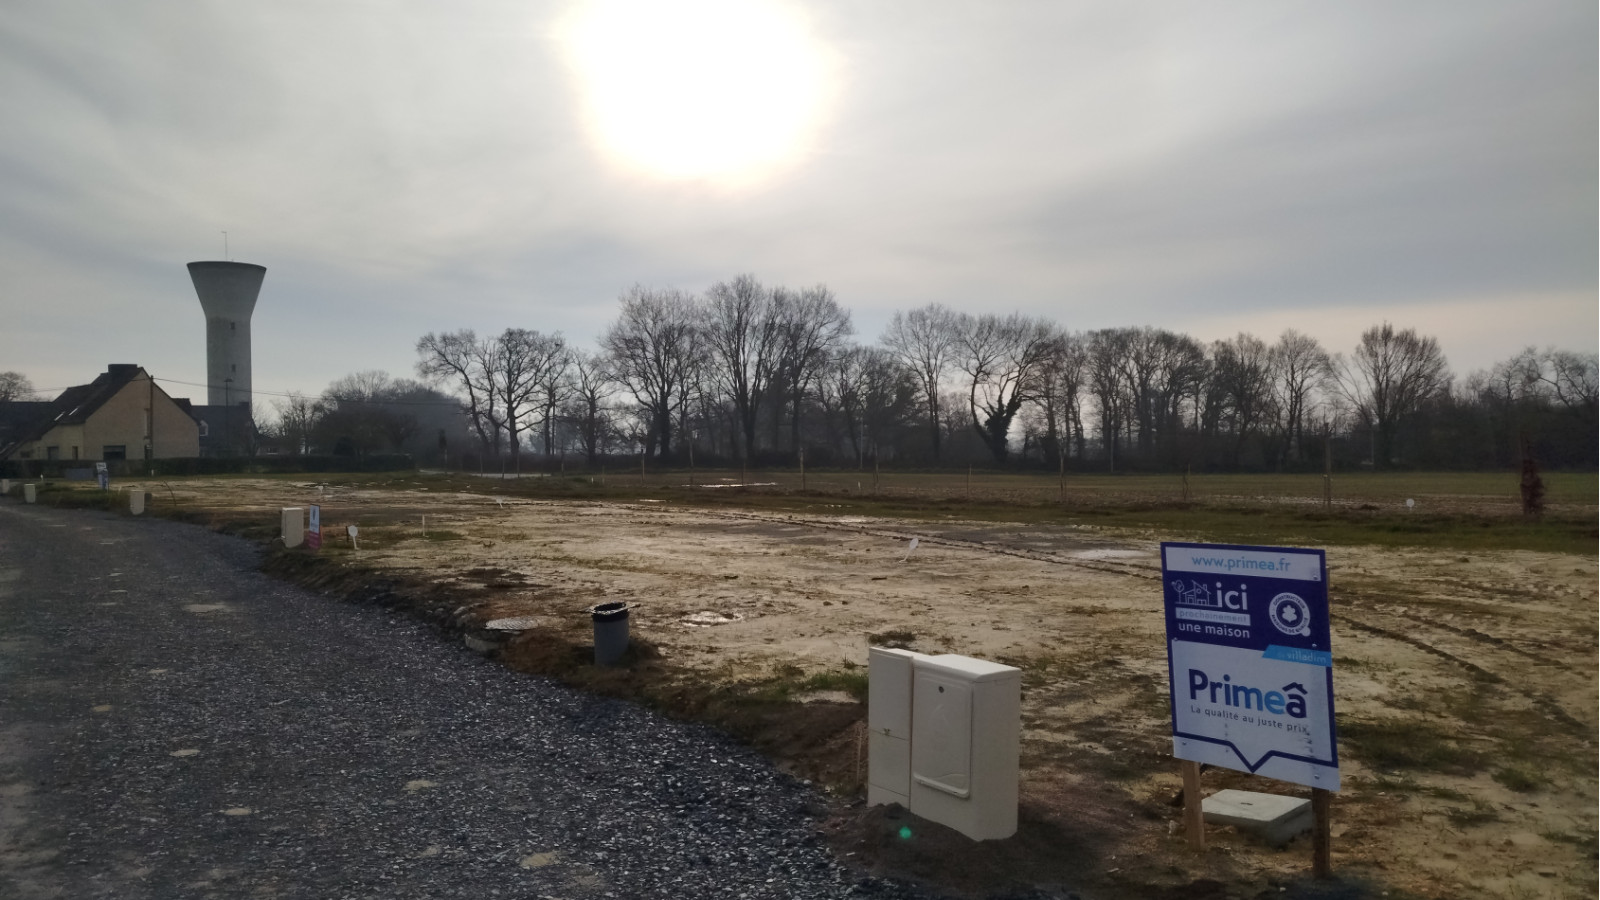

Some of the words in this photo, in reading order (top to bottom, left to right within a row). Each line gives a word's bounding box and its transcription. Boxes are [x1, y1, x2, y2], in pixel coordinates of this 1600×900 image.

[1191, 556, 1291, 572] www.primea.fr
[1215, 581, 1248, 610] ici
[1179, 610, 1246, 623] prochainement
[1178, 623, 1201, 633] une
[1205, 625, 1250, 639] maison
[1287, 650, 1327, 664] villadim
[1191, 706, 1201, 714] La
[1204, 709, 1239, 721] qualité
[1243, 715, 1254, 723] au
[1258, 717, 1283, 729] juste
